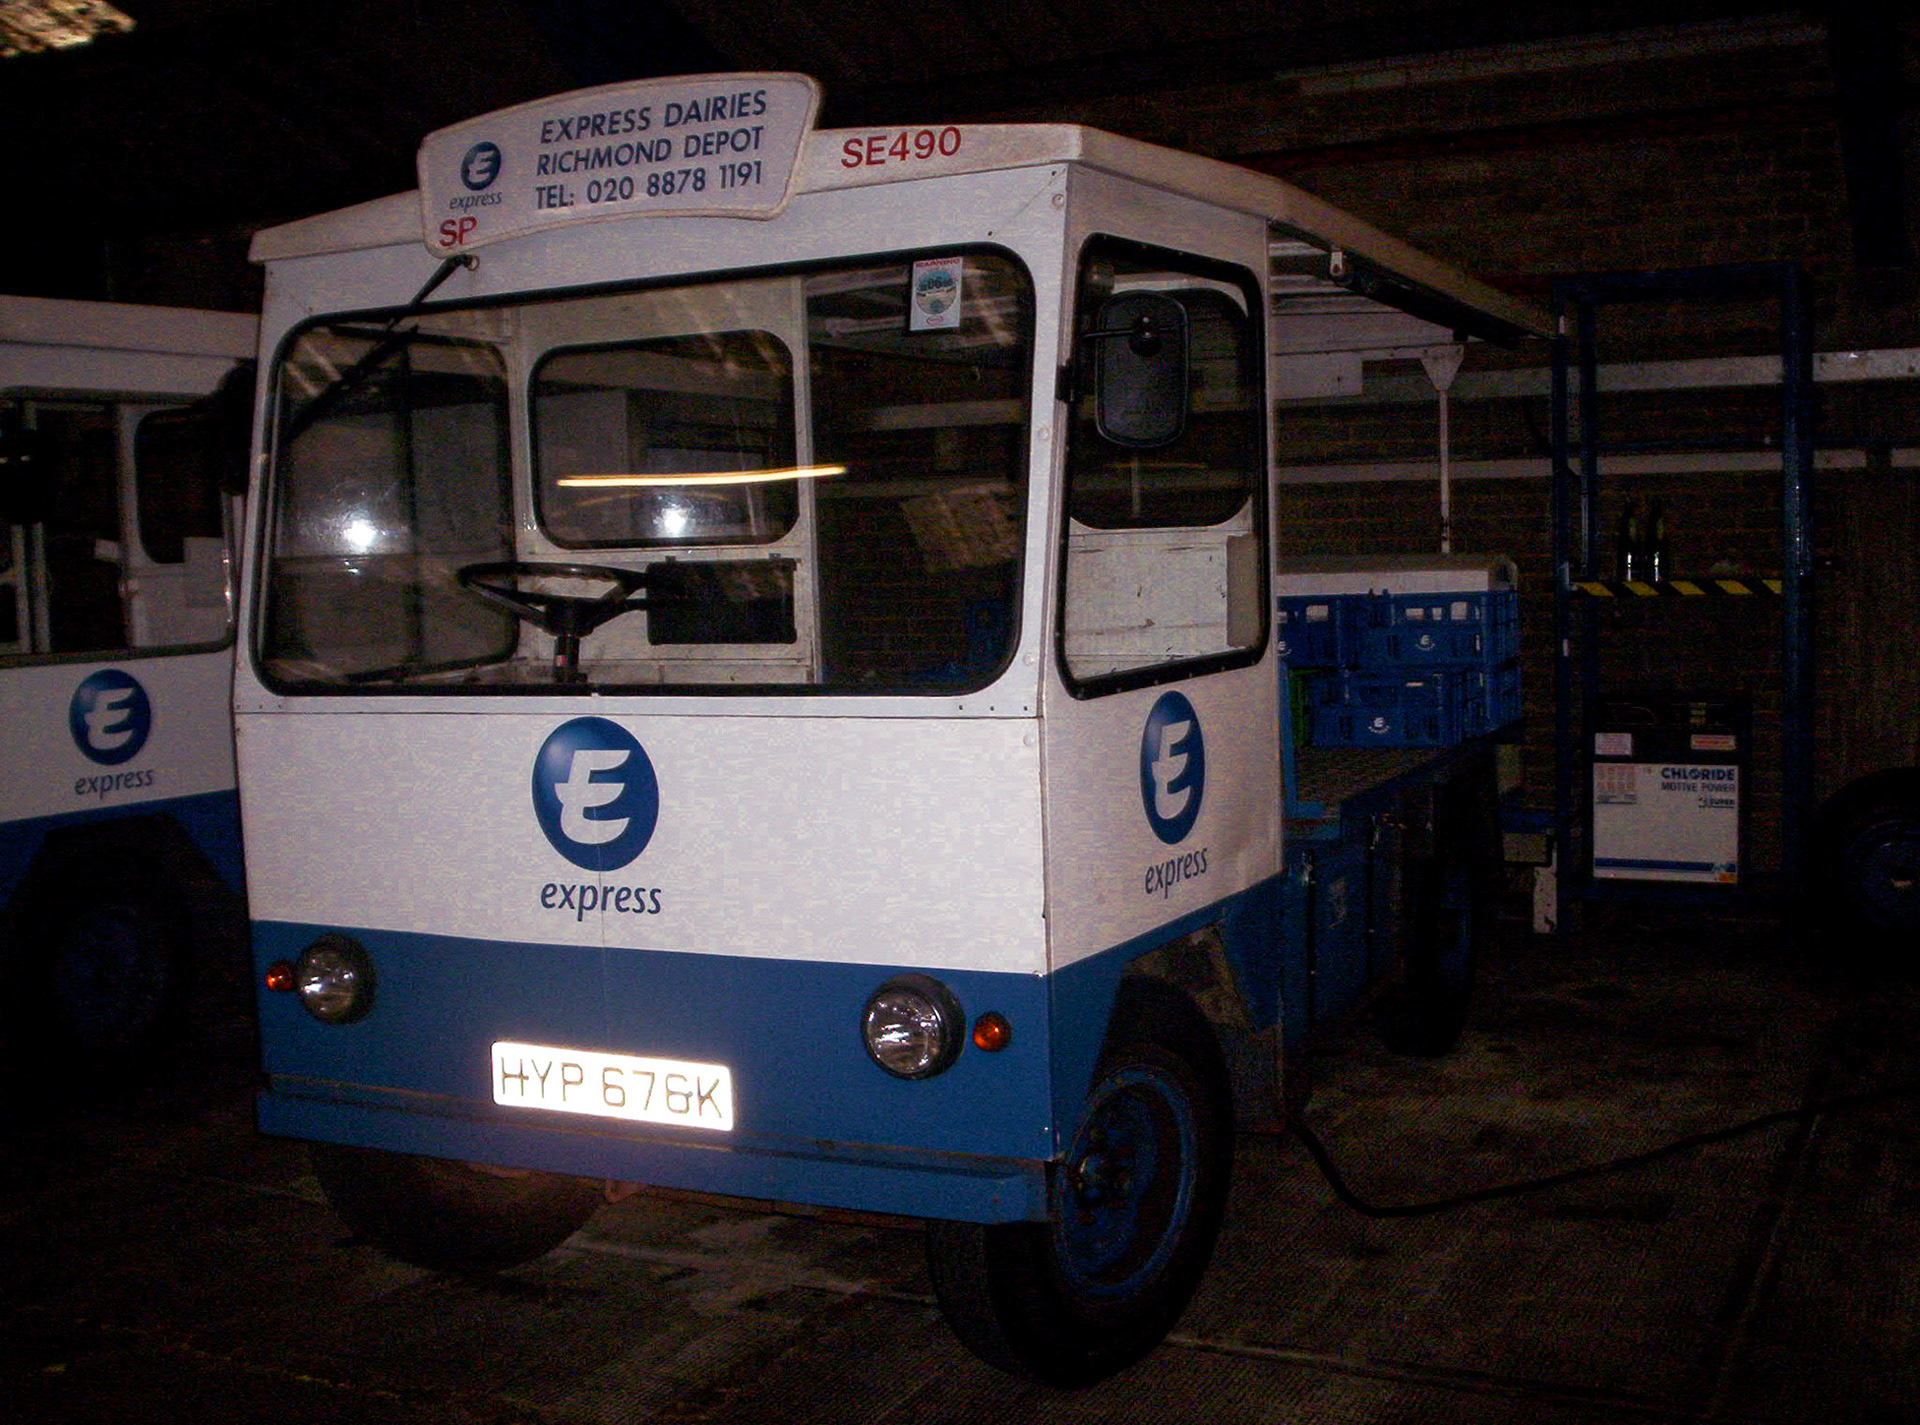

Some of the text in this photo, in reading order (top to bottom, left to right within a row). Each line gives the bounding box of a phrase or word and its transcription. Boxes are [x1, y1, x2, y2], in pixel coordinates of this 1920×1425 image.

[540, 89, 767, 144] EXPRESS DAIRIES
[536, 125, 765, 176] RICHMOND DEPOT
[841, 126, 961, 168] SE490
[449, 191, 503, 213] express
[536, 160, 762, 210] TEL: 020 8878 1191
[440, 216, 477, 246] SP
[74, 769, 154, 799] express
[1660, 767, 1736, 781] CHLORIDE
[1660, 782, 1736, 793] MOTIVE POWER
[1144, 847, 1208, 899] express
[540, 882, 662, 922] express
[501, 1056, 722, 1119] HYP 676K
